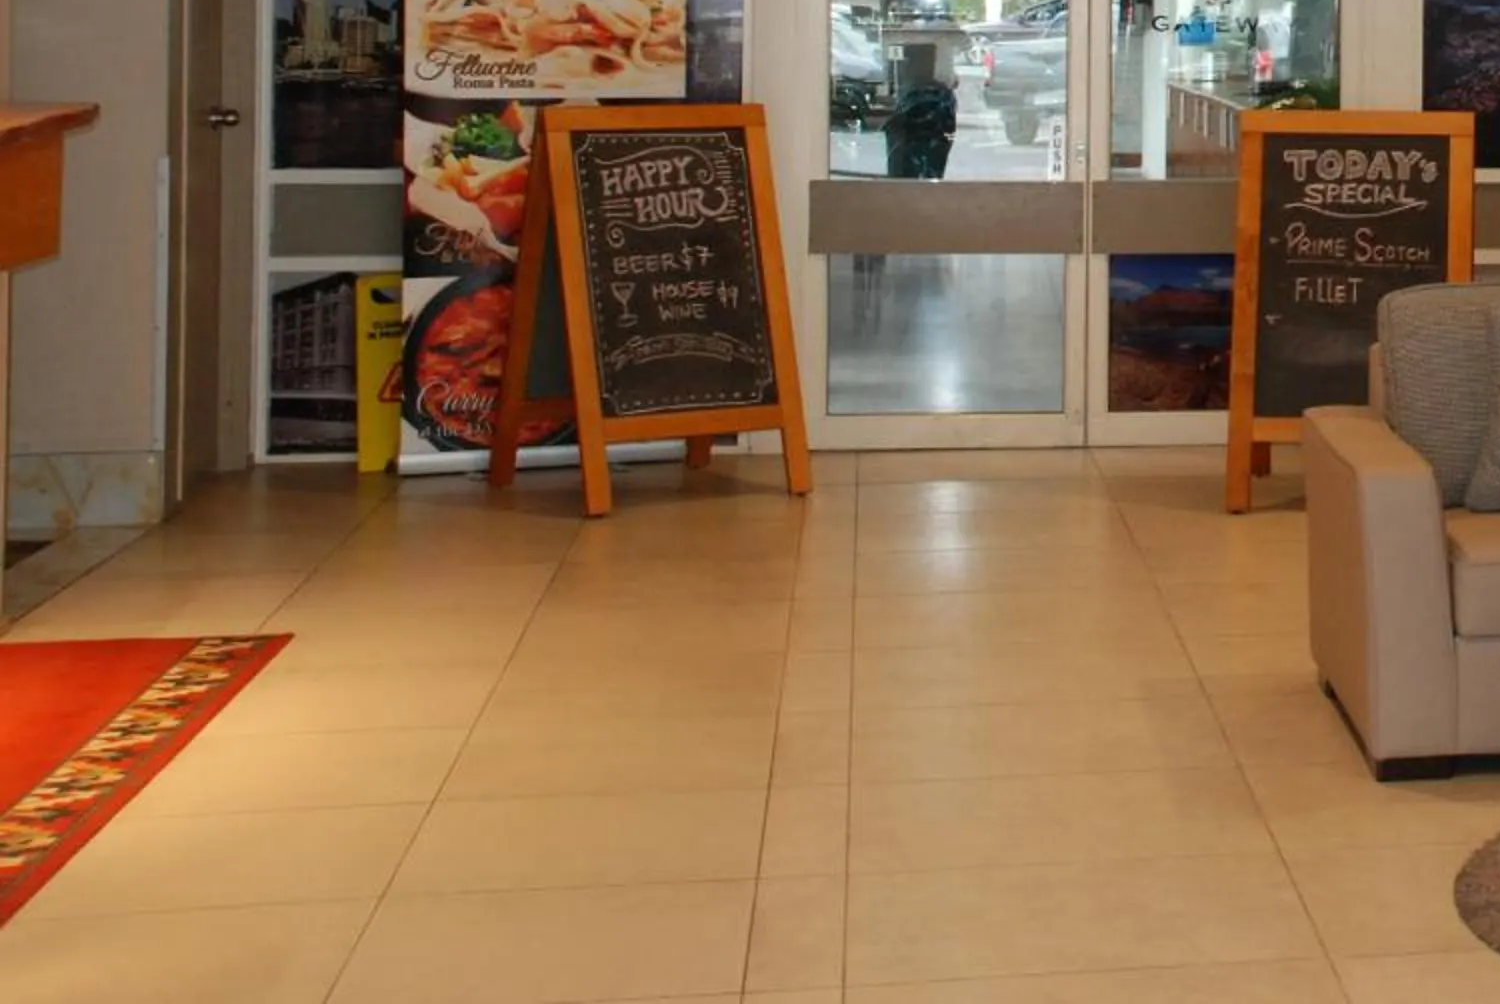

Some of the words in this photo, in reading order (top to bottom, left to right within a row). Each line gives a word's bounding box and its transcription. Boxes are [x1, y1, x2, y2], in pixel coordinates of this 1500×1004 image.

[453, 77, 494, 89] Roma
[499, 77, 535, 89] Pasta
[1053, 125, 1062, 173] PUSH
[600, 156, 694, 196] HAPPY
[634, 186, 728, 223] HOUR
[1303, 183, 1416, 205] SPECIAL
[613, 253, 678, 275] BEER
[652, 280, 715, 301] HOUSE
[658, 303, 708, 321] WINE
[416, 381, 497, 424] Curry
